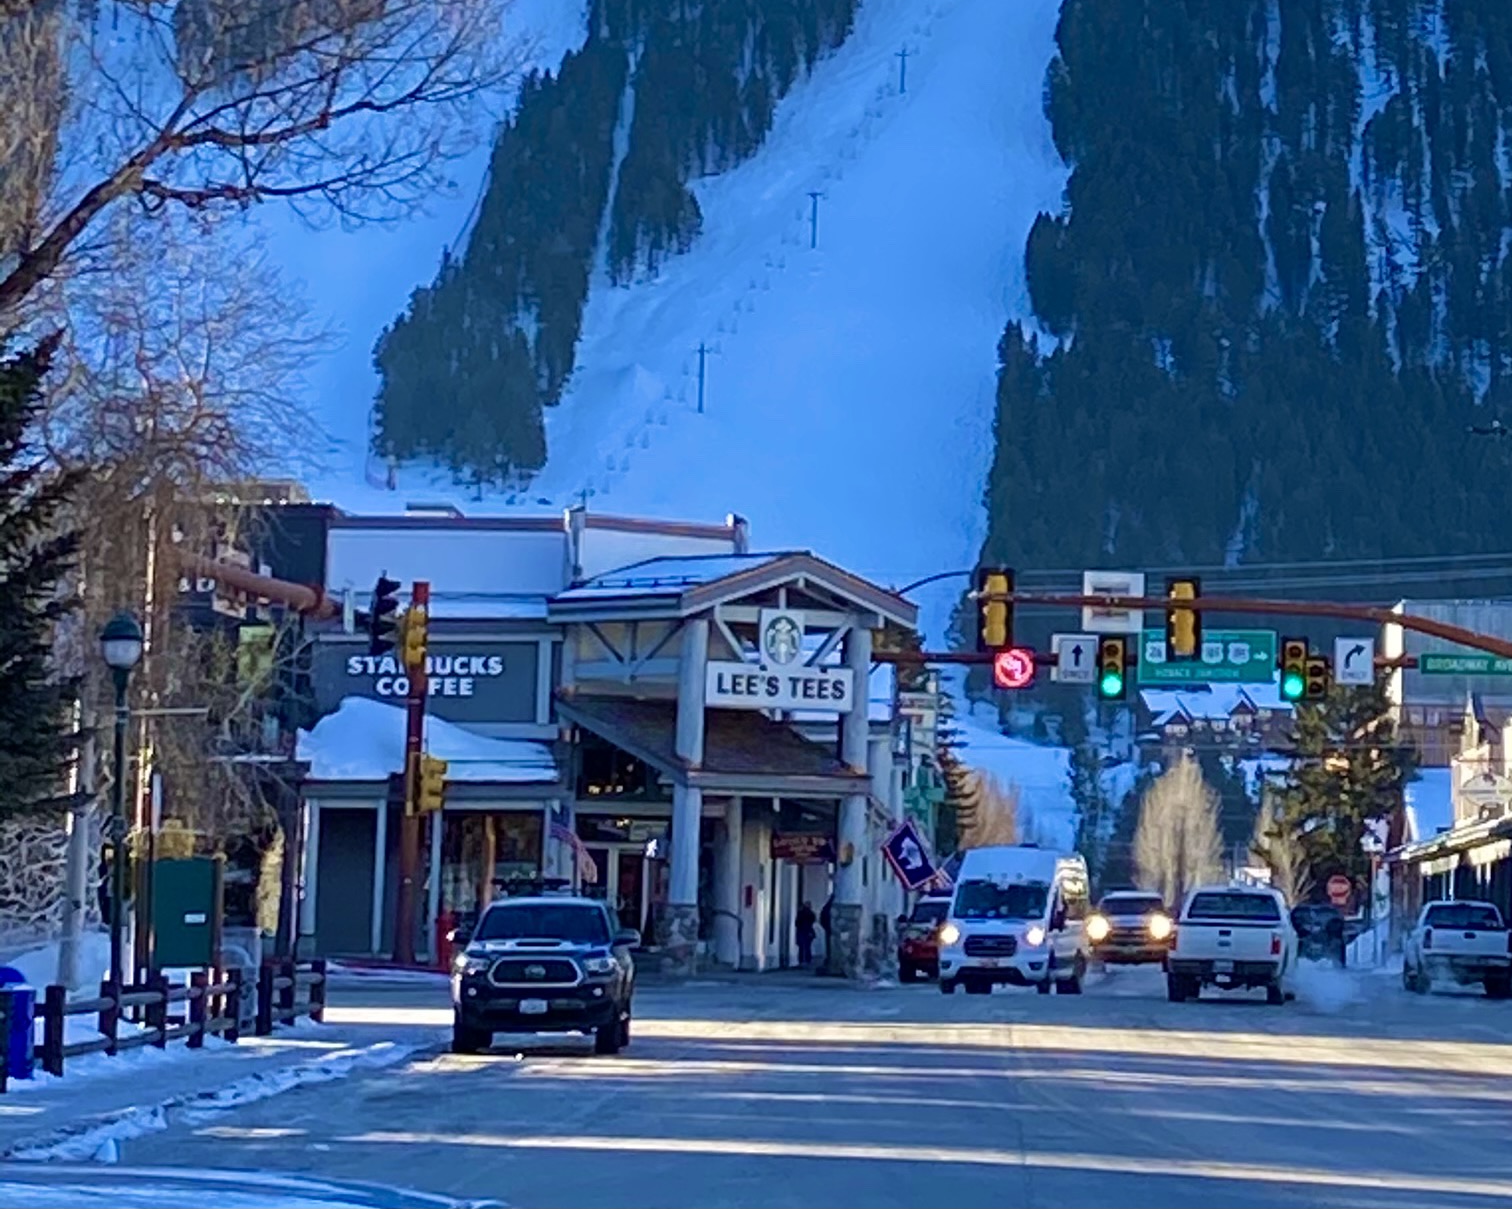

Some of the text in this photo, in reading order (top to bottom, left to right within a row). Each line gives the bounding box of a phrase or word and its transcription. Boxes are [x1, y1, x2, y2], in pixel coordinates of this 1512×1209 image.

[347, 656, 503, 675] STABUCKS
[1426, 657, 1489, 671] BROADWAY
[376, 677, 473, 695] COFEE
[717, 672, 845, 700] LEE'S TEES
